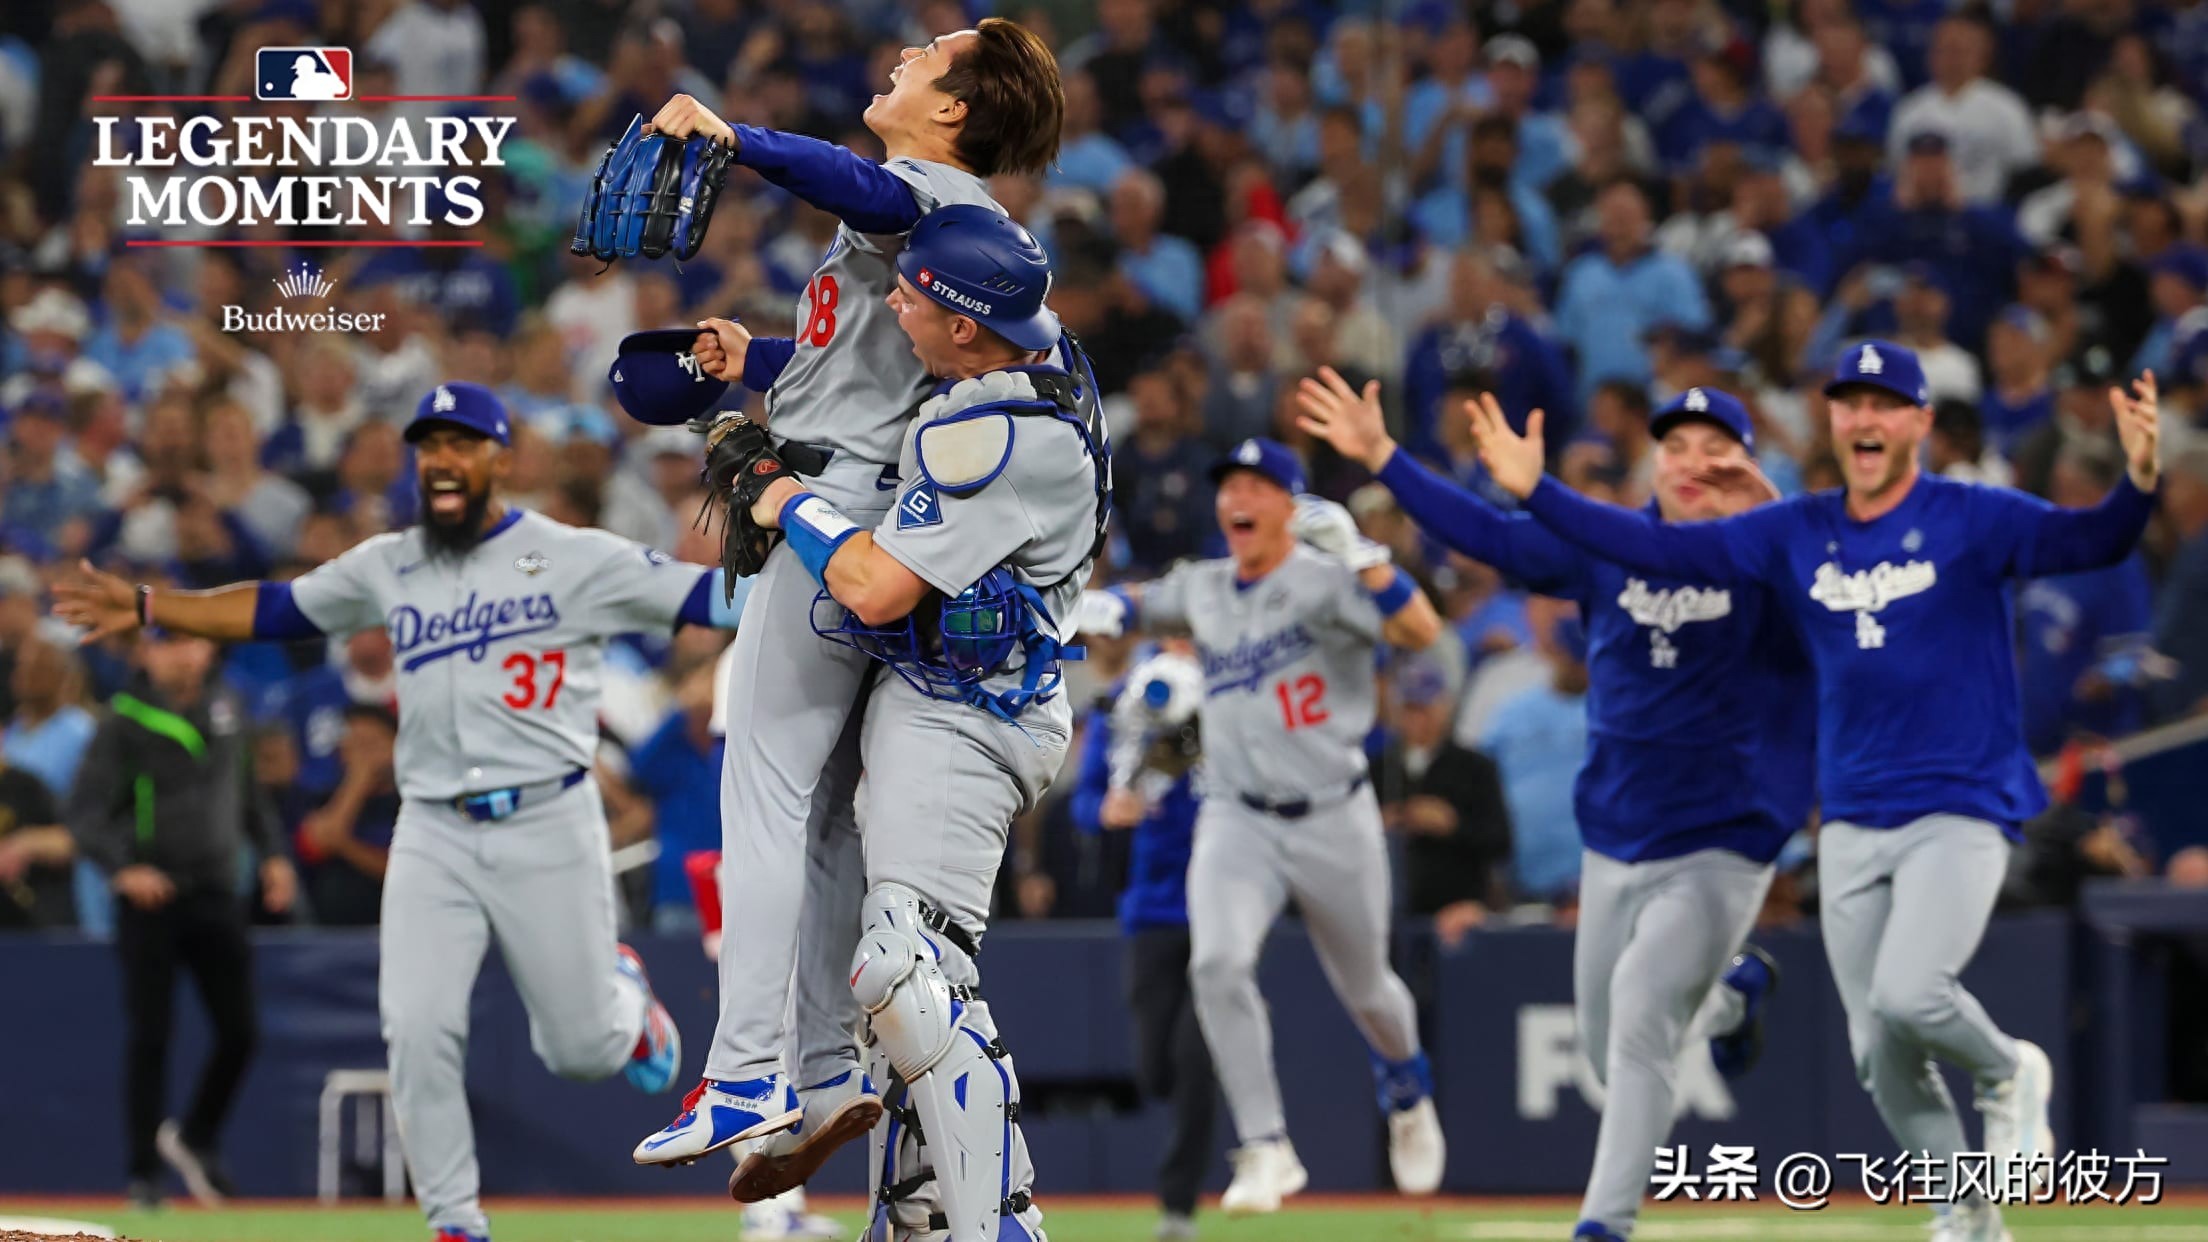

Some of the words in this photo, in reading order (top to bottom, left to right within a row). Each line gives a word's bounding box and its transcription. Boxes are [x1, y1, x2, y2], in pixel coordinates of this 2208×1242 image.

[931, 281, 992, 315] STRAUSS
[909, 490, 932, 513] G
[387, 591, 560, 667] Dodgers
[503, 650, 564, 709] 37
[1277, 671, 1330, 730] 12
